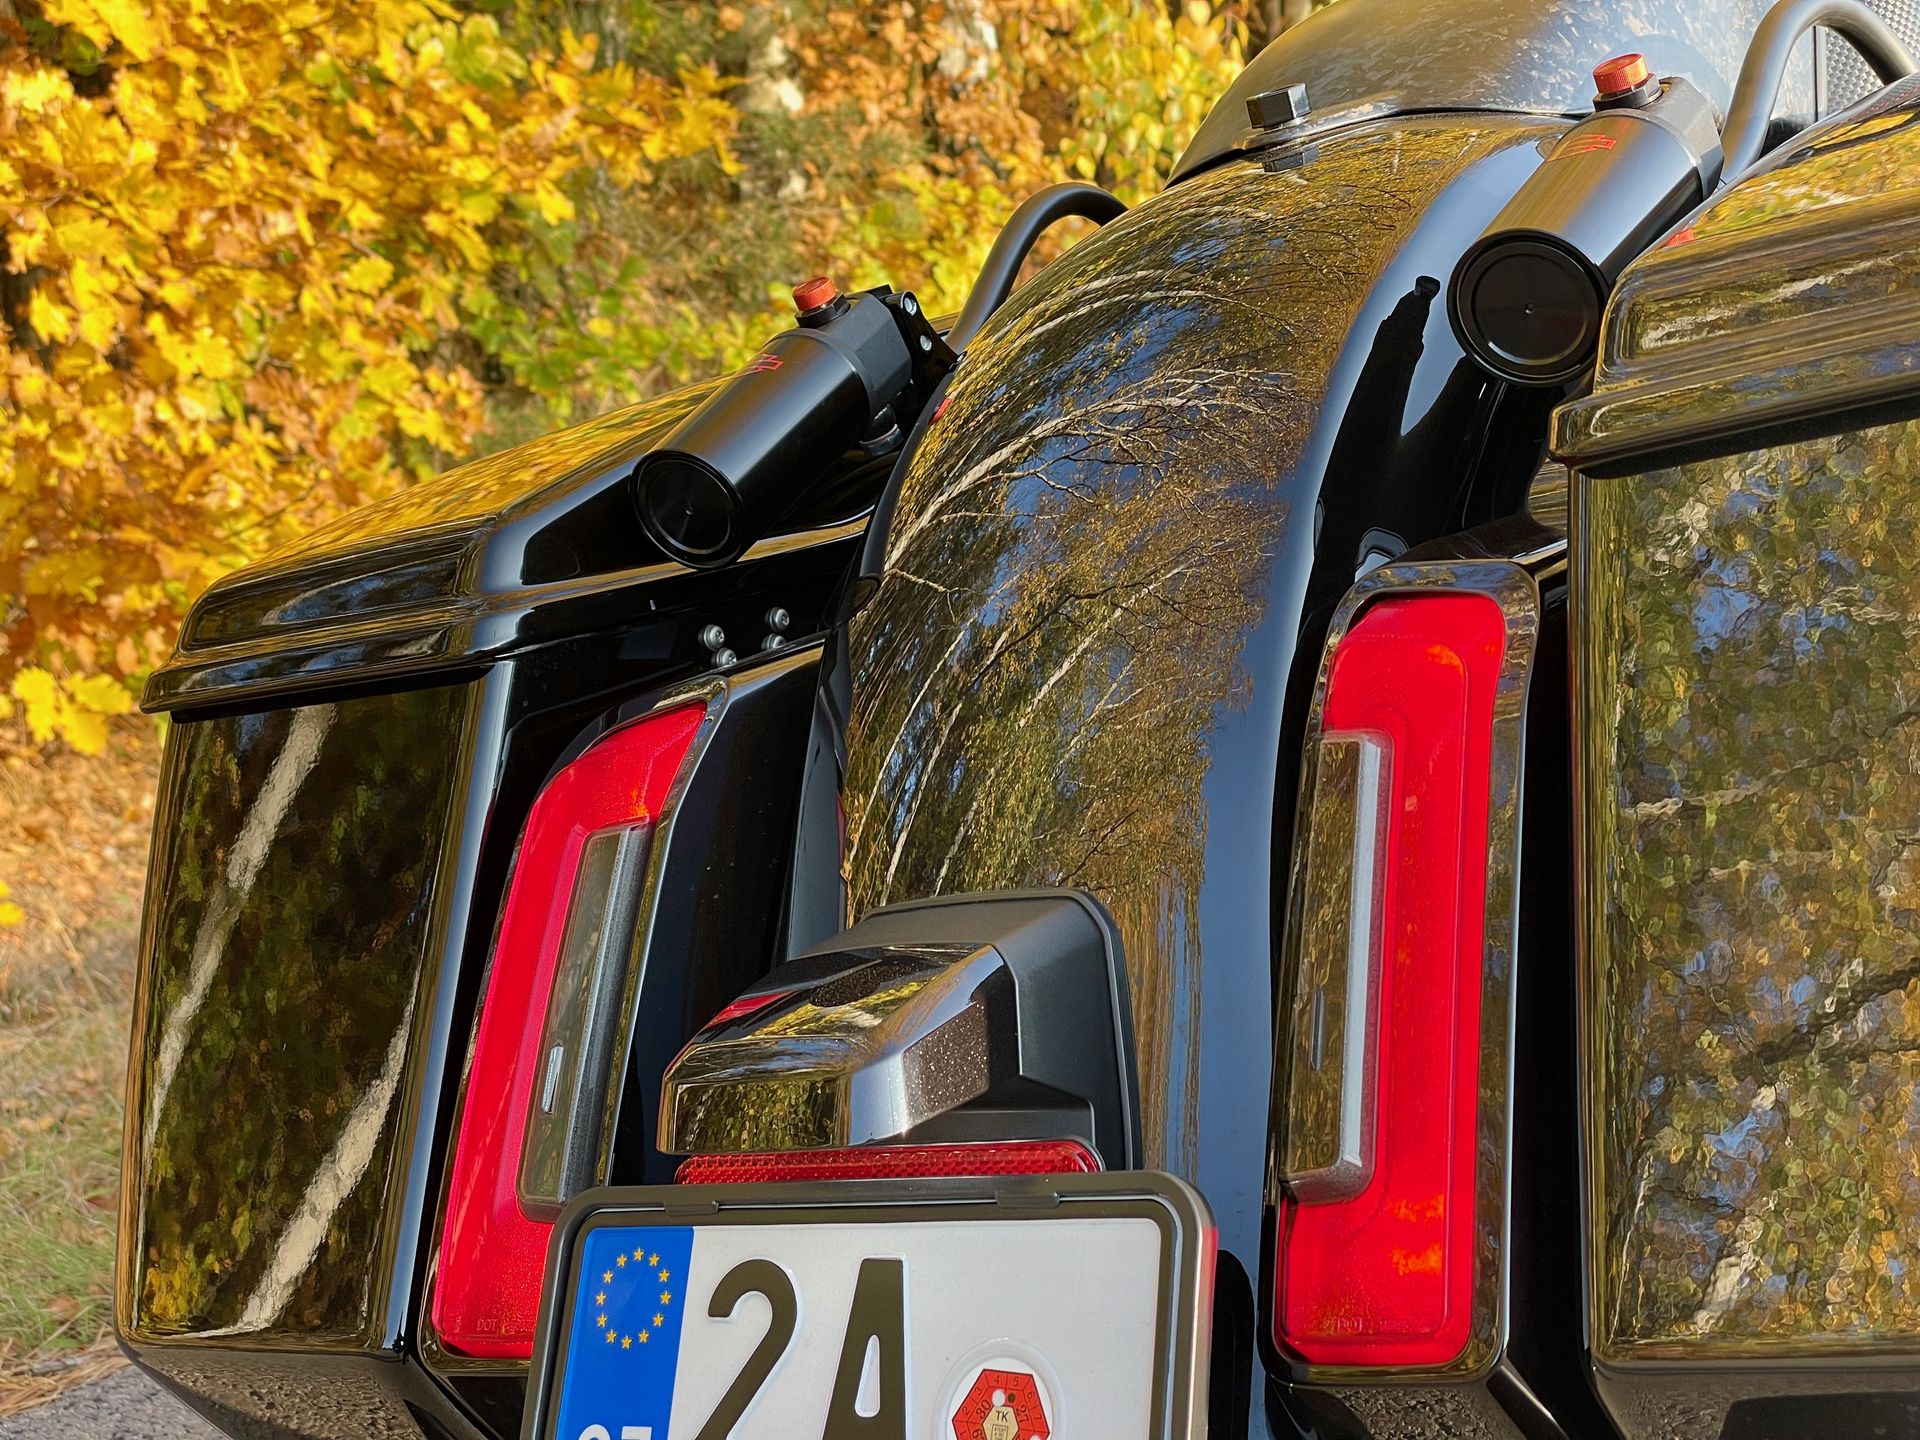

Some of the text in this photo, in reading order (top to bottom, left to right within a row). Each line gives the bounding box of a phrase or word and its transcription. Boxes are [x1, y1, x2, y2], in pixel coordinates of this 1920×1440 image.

[475, 1317, 499, 1332] DOT
[695, 1258, 907, 1440] 2A
[1013, 1376, 1019, 1387] 5
[975, 1386, 983, 1396] 3
[1027, 1391, 1035, 1400] 6
[962, 1406, 971, 1416] 2
[976, 1399, 991, 1419] 30
[1015, 1404, 1030, 1423] 27
[996, 1410, 1009, 1423] TK
